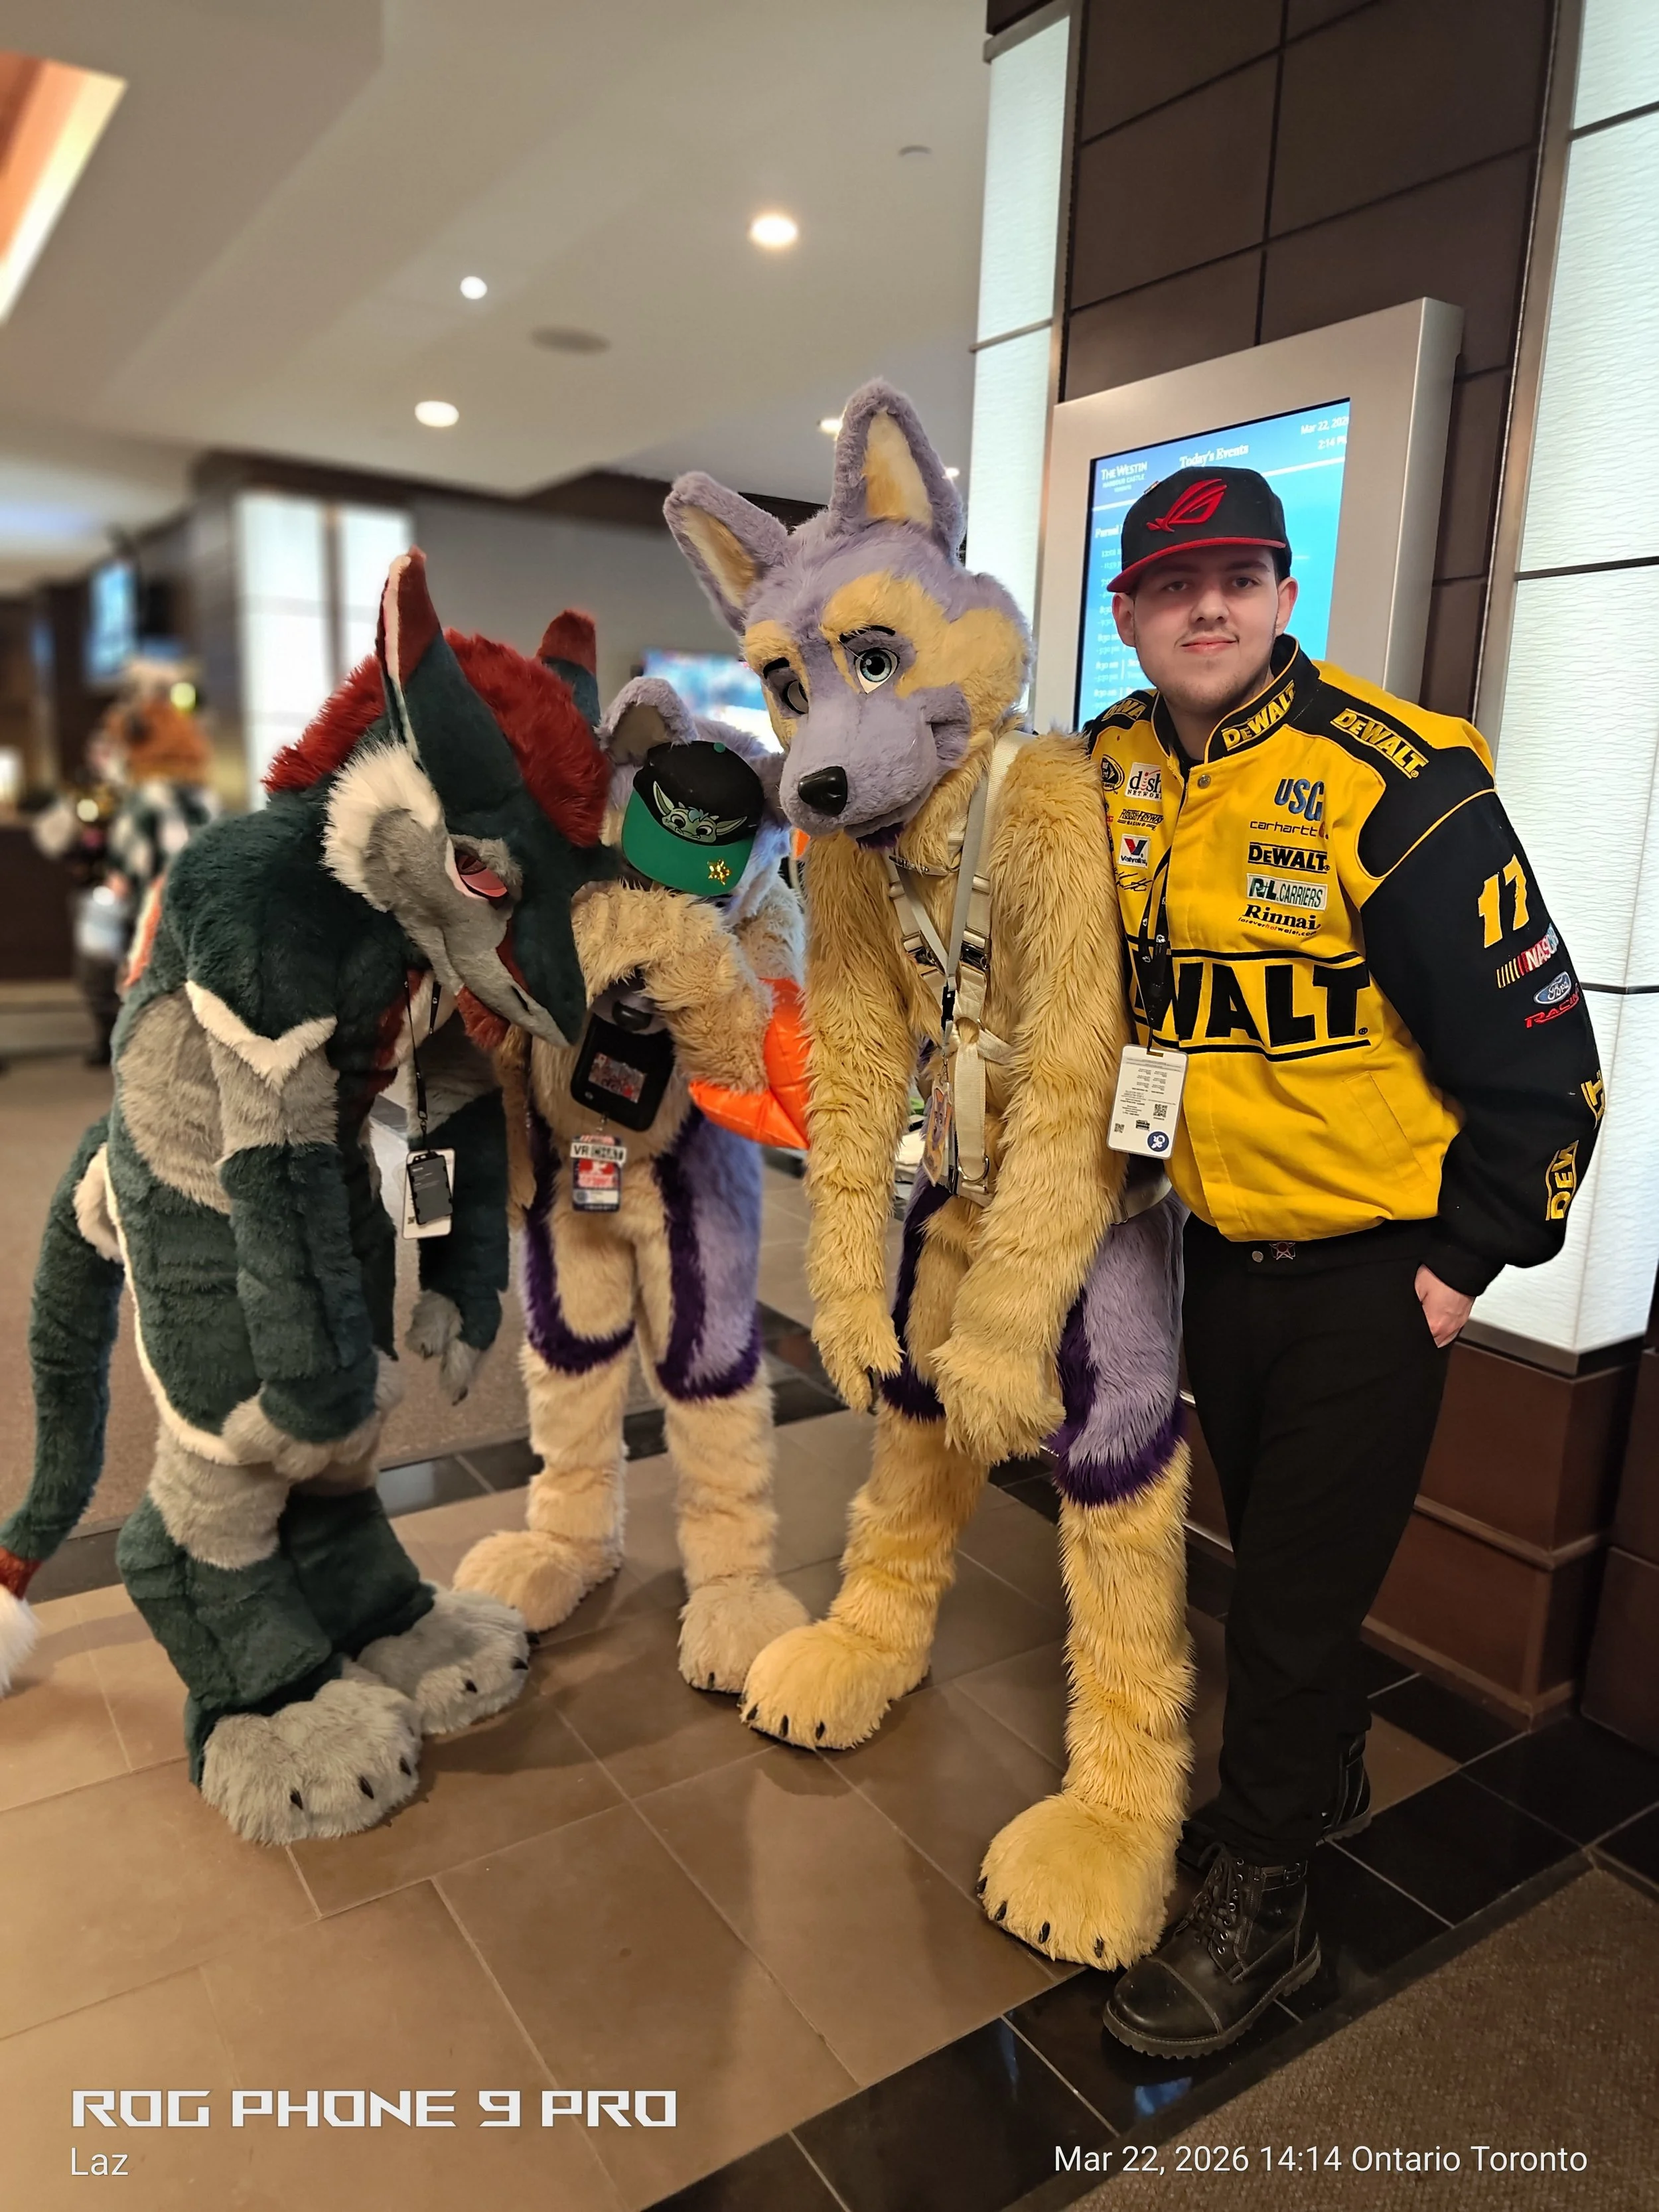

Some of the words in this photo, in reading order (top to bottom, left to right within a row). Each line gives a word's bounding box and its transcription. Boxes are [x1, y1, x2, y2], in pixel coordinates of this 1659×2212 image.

[1301, 424, 1317, 435] Mar
[1179, 449, 1214, 467] Today's
[1216, 444, 1249, 461] Events
[1101, 468, 1117, 480] THE
[1116, 461, 1148, 477] WESTIN
[1129, 771, 1161, 794] dish
[1127, 789, 1162, 800] NETWOR
[1274, 778, 1325, 821] USG
[1249, 821, 1318, 837] carhartt
[1279, 883, 1323, 909] CARRIERS
[1478, 853, 1530, 948] 17
[1242, 904, 1318, 930] Rinnai
